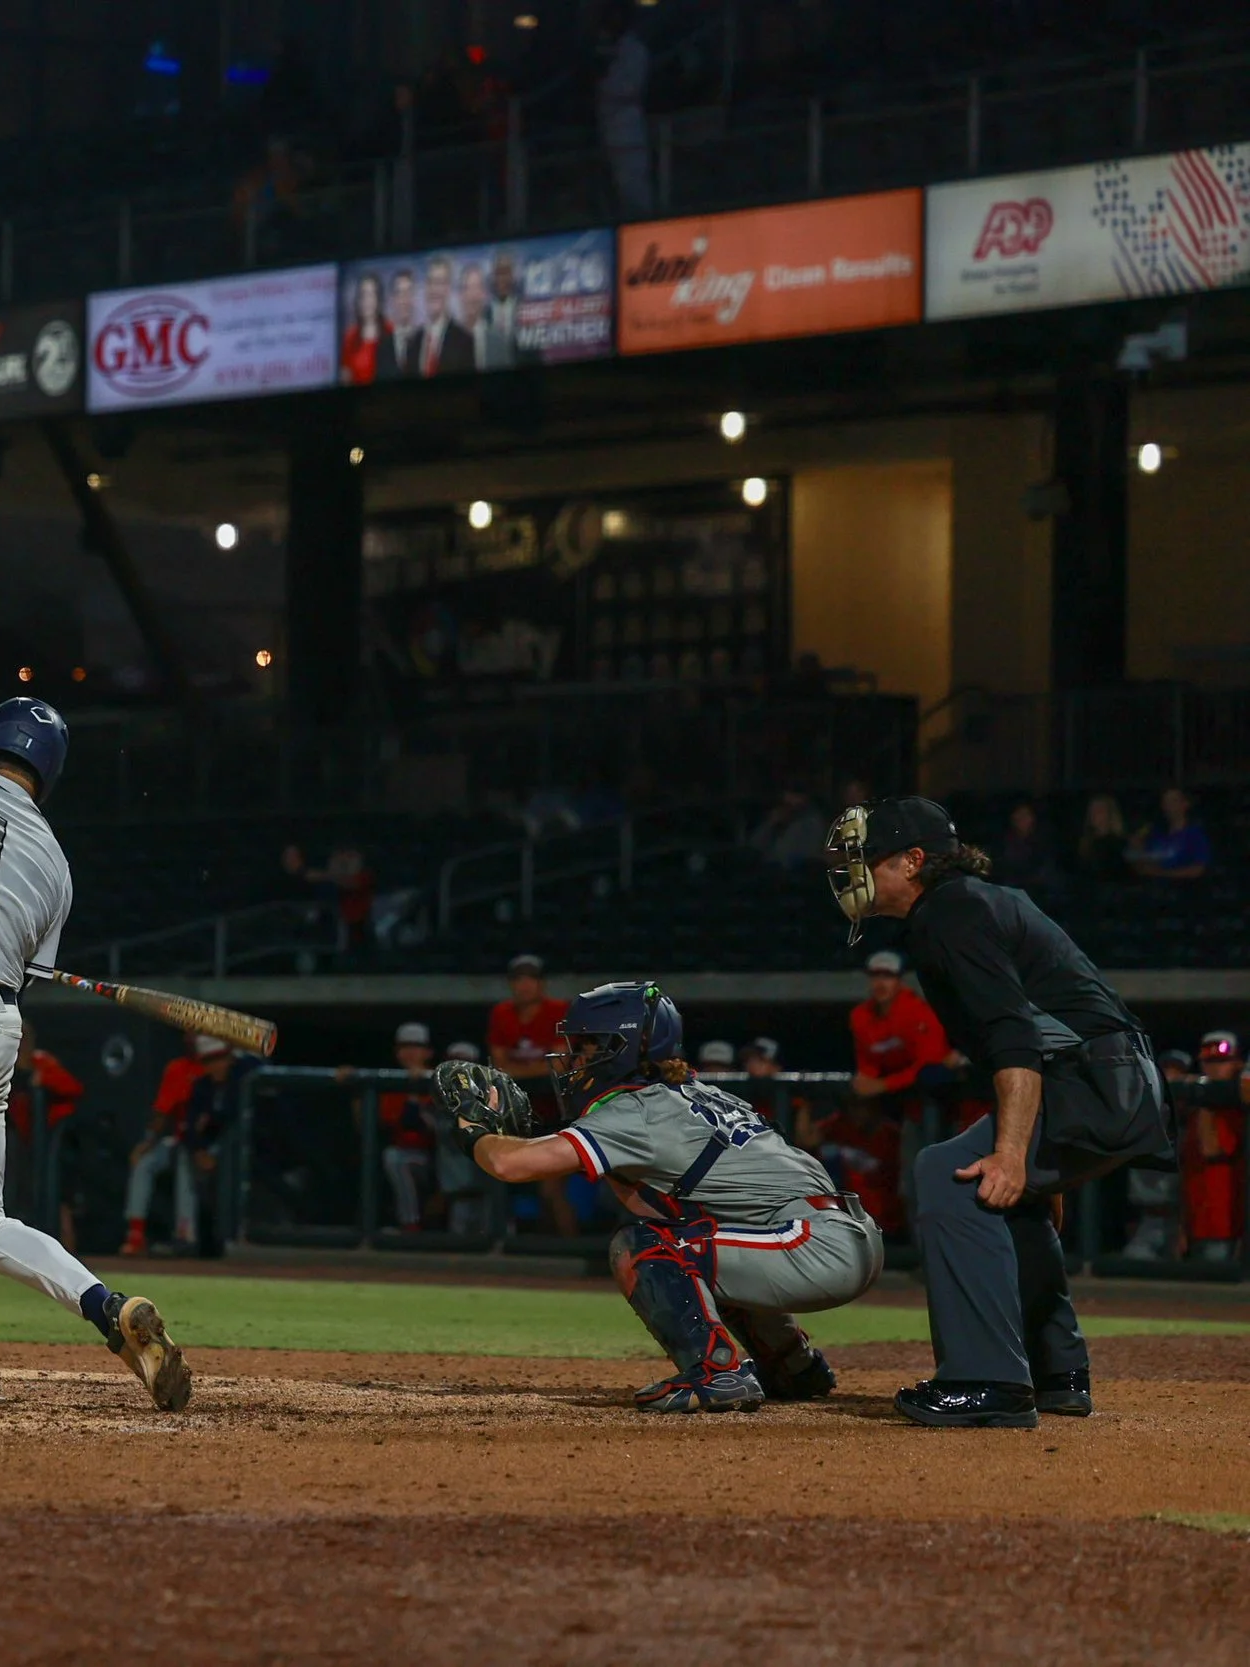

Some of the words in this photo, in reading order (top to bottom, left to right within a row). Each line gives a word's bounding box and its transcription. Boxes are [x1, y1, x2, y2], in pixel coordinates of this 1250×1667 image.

[973, 197, 1054, 262] ADP
[94, 314, 210, 376] GMC
[517, 319, 610, 349] WEATHER
